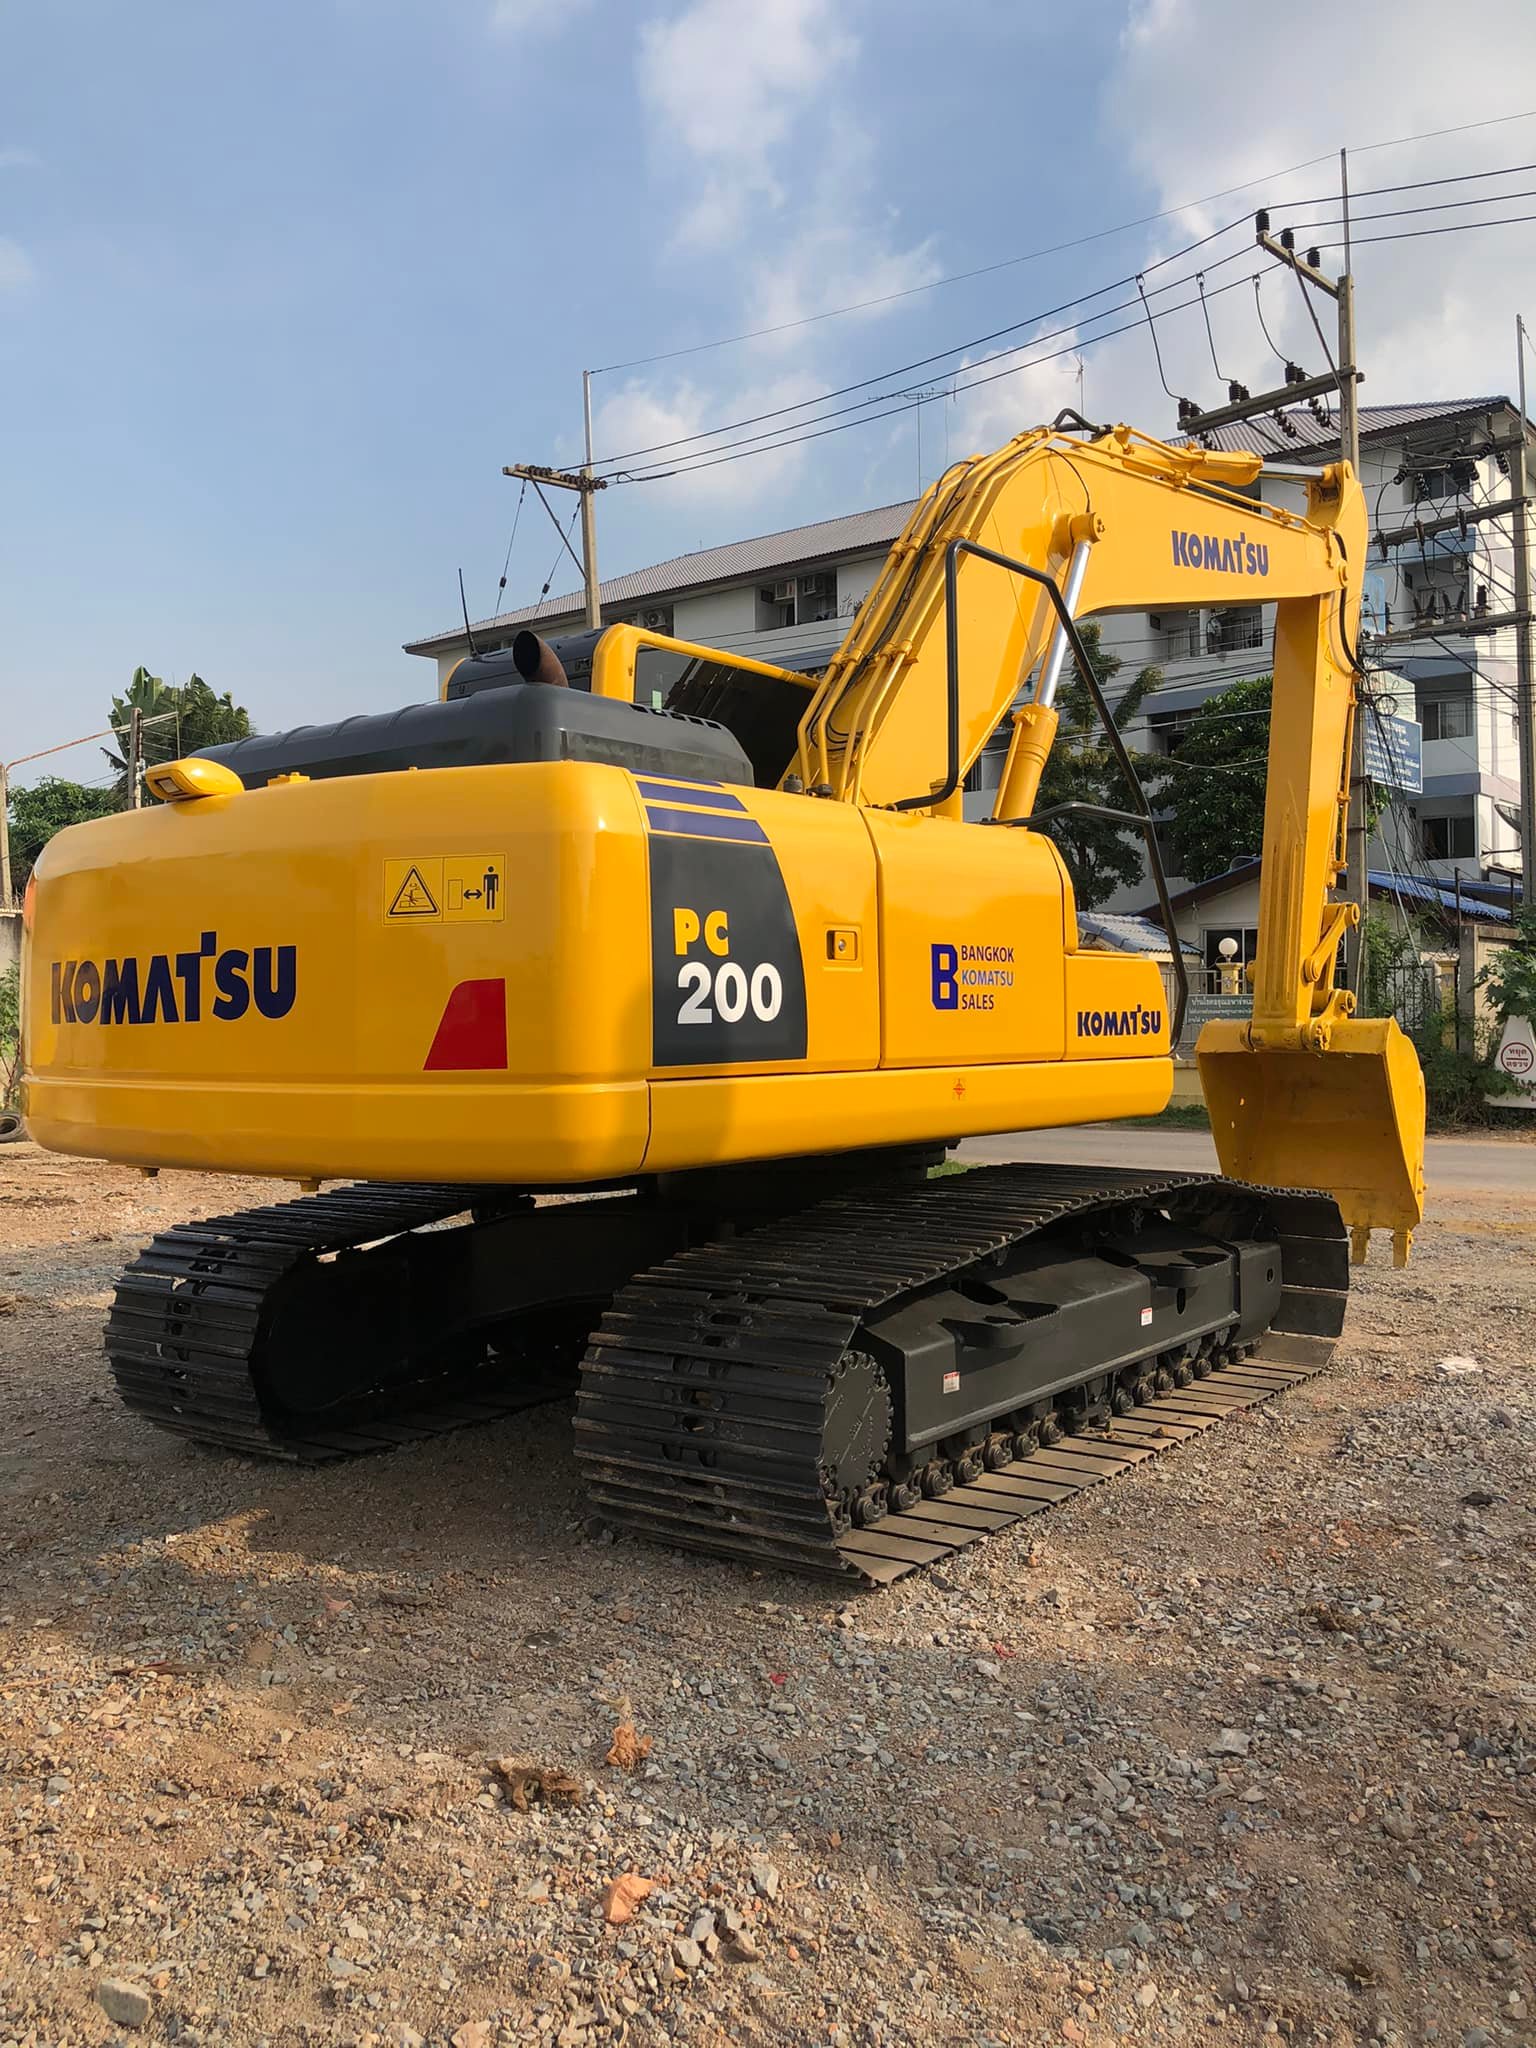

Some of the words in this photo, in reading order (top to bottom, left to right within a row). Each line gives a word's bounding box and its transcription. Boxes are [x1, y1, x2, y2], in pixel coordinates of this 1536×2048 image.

[1172, 530, 1269, 577] KOMATSU
[673, 908, 729, 957] PC
[961, 945, 1014, 962] BANGKOK
[51, 931, 297, 1026] KOMATSU
[677, 962, 783, 1024] 200
[961, 969, 1014, 987] KOMATSU
[961, 993, 994, 1010] SALES
[1077, 1003, 1161, 1037] KOMATSU
